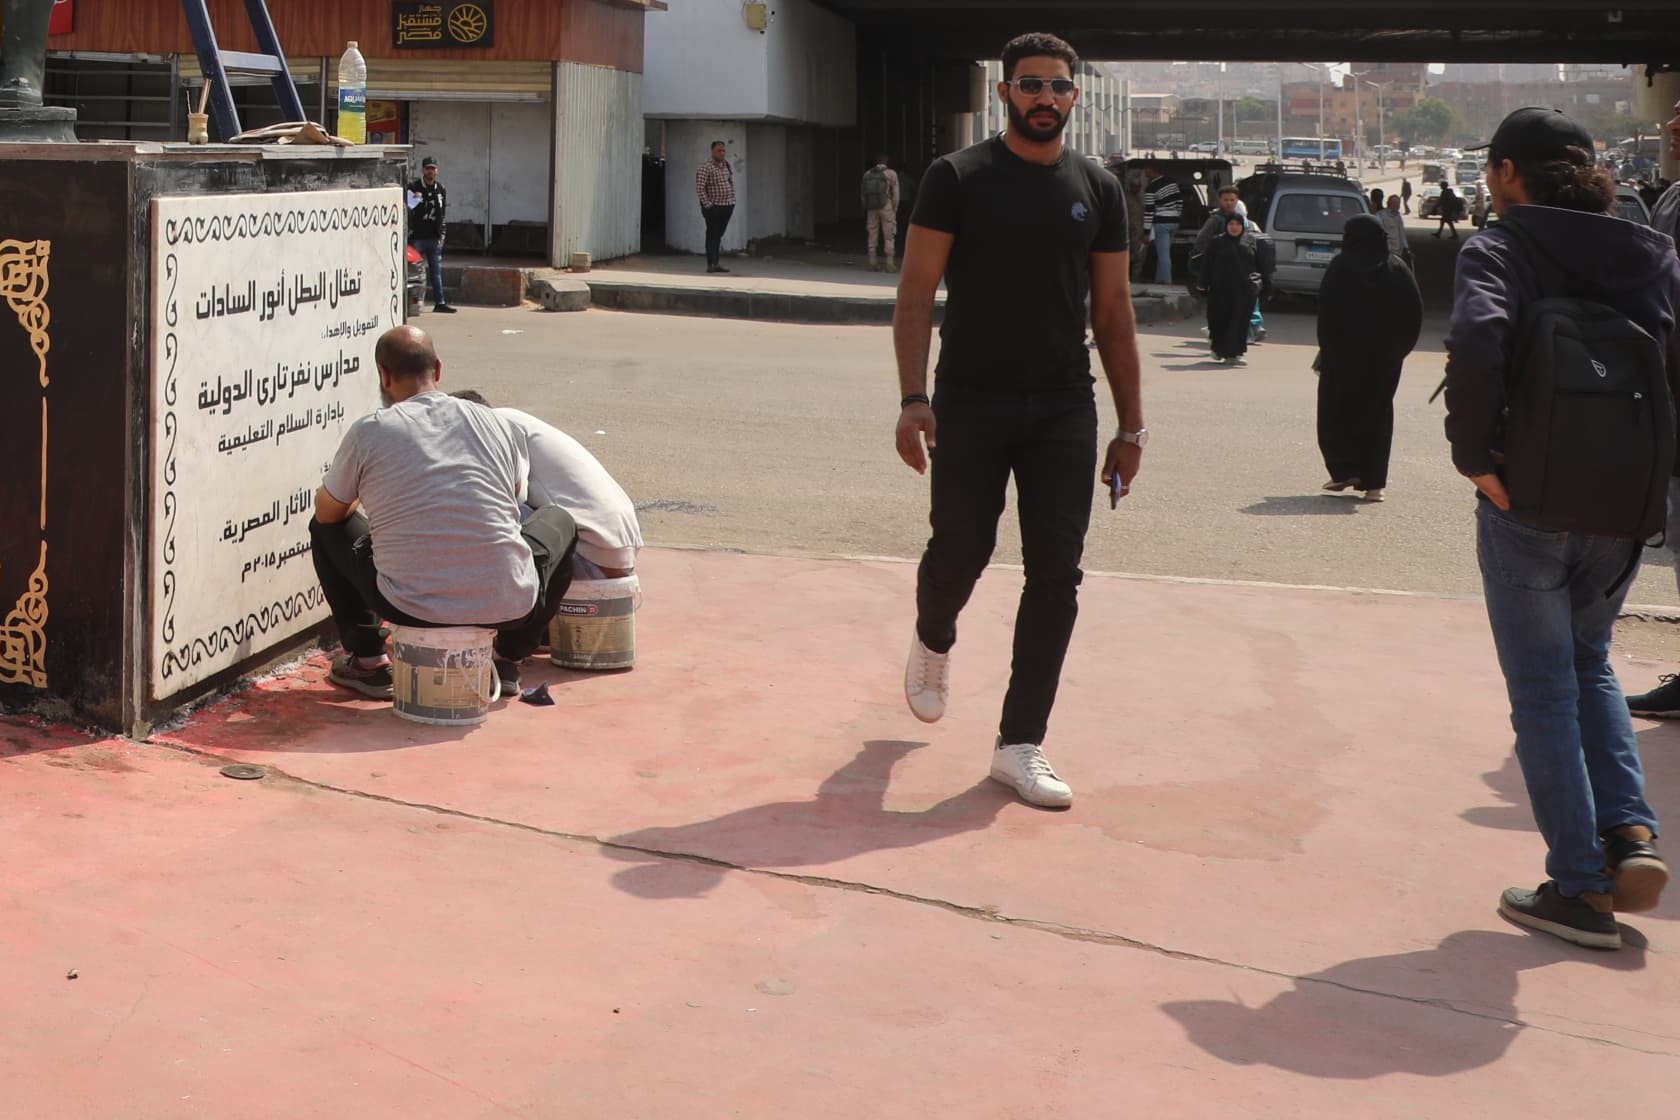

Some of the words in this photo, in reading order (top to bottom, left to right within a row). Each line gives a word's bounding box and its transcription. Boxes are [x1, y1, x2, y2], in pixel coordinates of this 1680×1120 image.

[196, 280, 256, 320] السادات
[259, 269, 285, 322] أنور
[288, 271, 326, 316] البطل
[329, 267, 362, 310] تمثال
[198, 368, 253, 415] الدولية
[314, 349, 360, 392] مدارس
[275, 408, 313, 447] السلام
[315, 400, 345, 430] بإدارة
[218, 418, 273, 456] التعليمية
